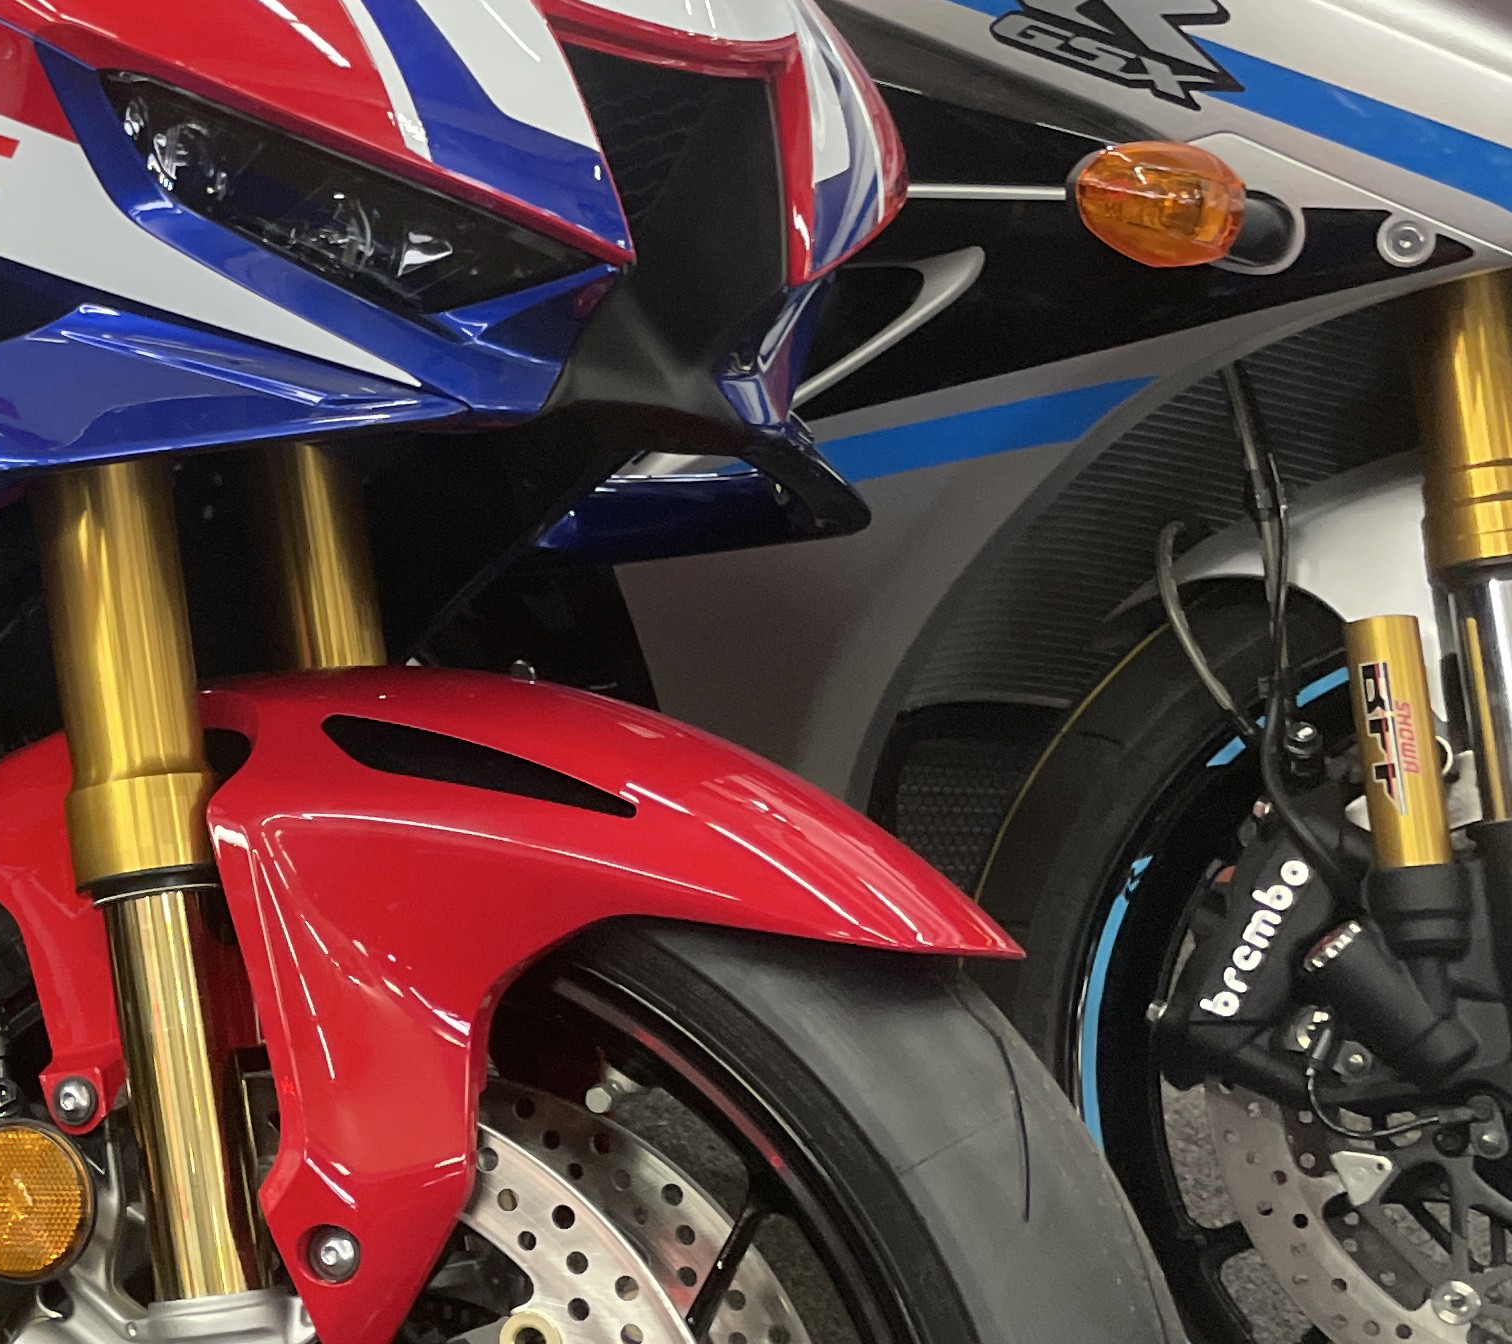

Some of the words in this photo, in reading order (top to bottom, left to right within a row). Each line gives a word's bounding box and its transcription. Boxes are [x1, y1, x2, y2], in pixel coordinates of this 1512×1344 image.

[990, 8, 1202, 112] GSX
[1394, 699, 1420, 775] SHOWA
[1199, 859, 1311, 1019] brembo
